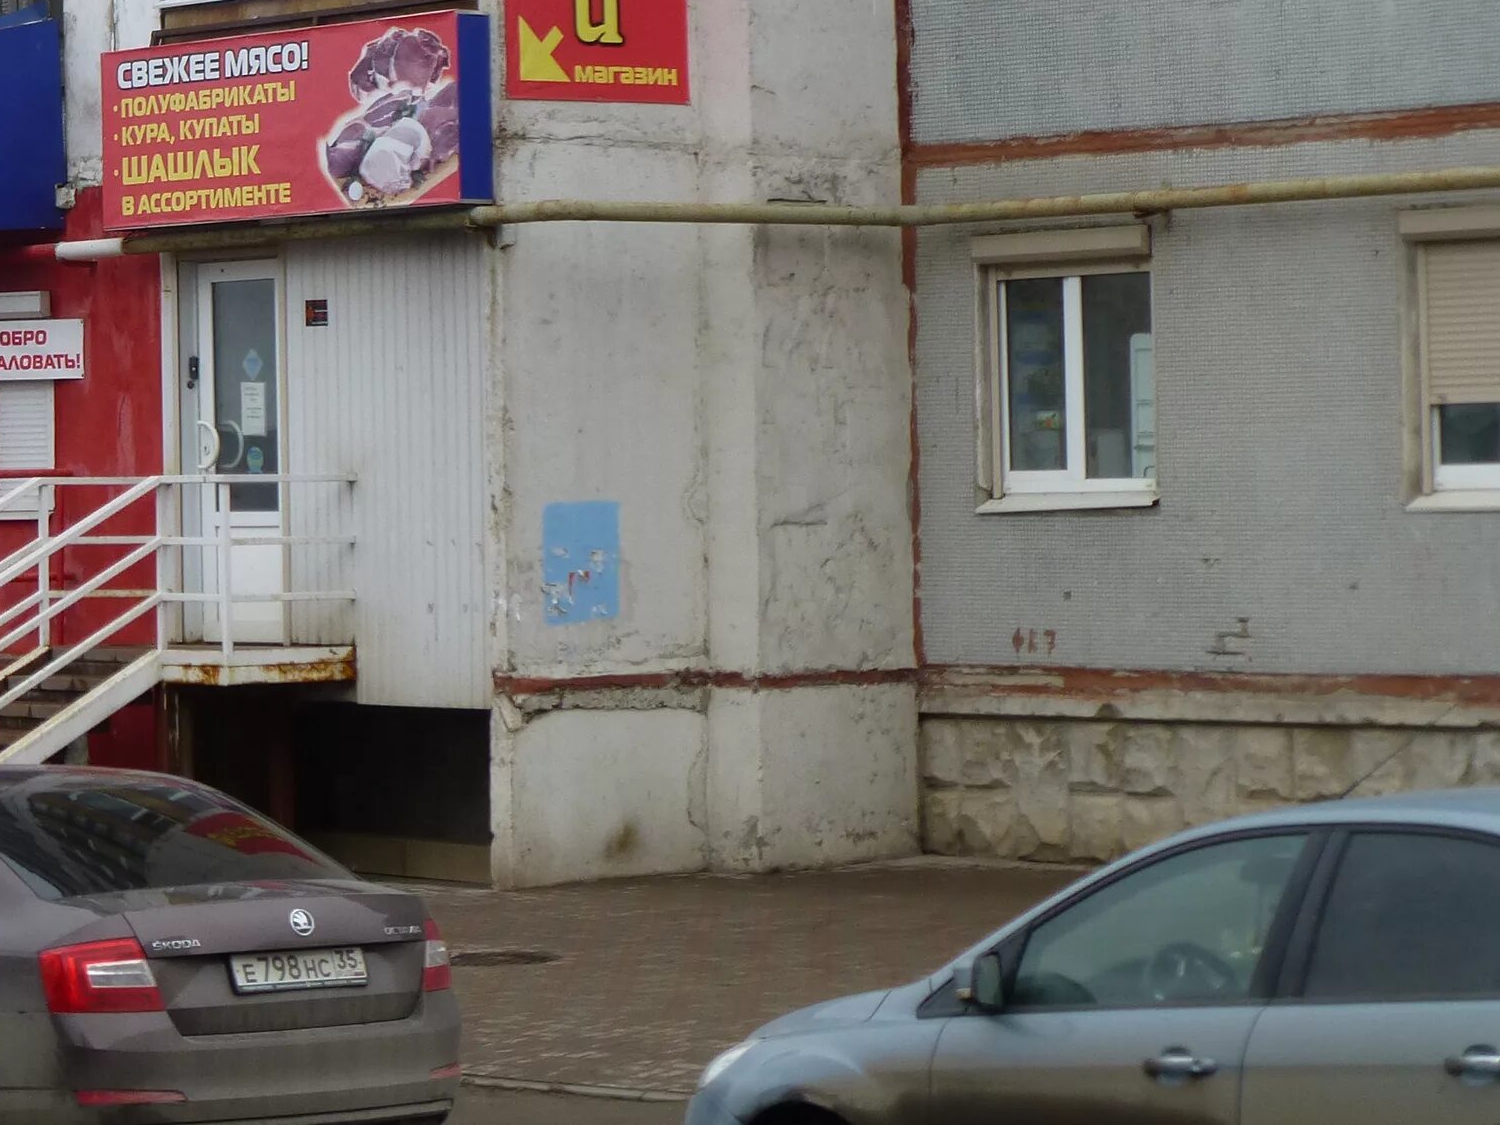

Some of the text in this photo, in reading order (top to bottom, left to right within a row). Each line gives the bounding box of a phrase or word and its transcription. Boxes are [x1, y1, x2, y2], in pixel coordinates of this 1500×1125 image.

[116, 41, 309, 90] СВЕЖЕЕ МЯСО!
[120, 80, 296, 118] ПОЛУФАБРИКАТЫ
[121, 113, 260, 147] КУРА, КУПАТЫ
[121, 144, 261, 185] ШАШЛЫК
[122, 182, 291, 216] В АССОРТИМЕНТЕ
[334, 949, 357, 968] 35
